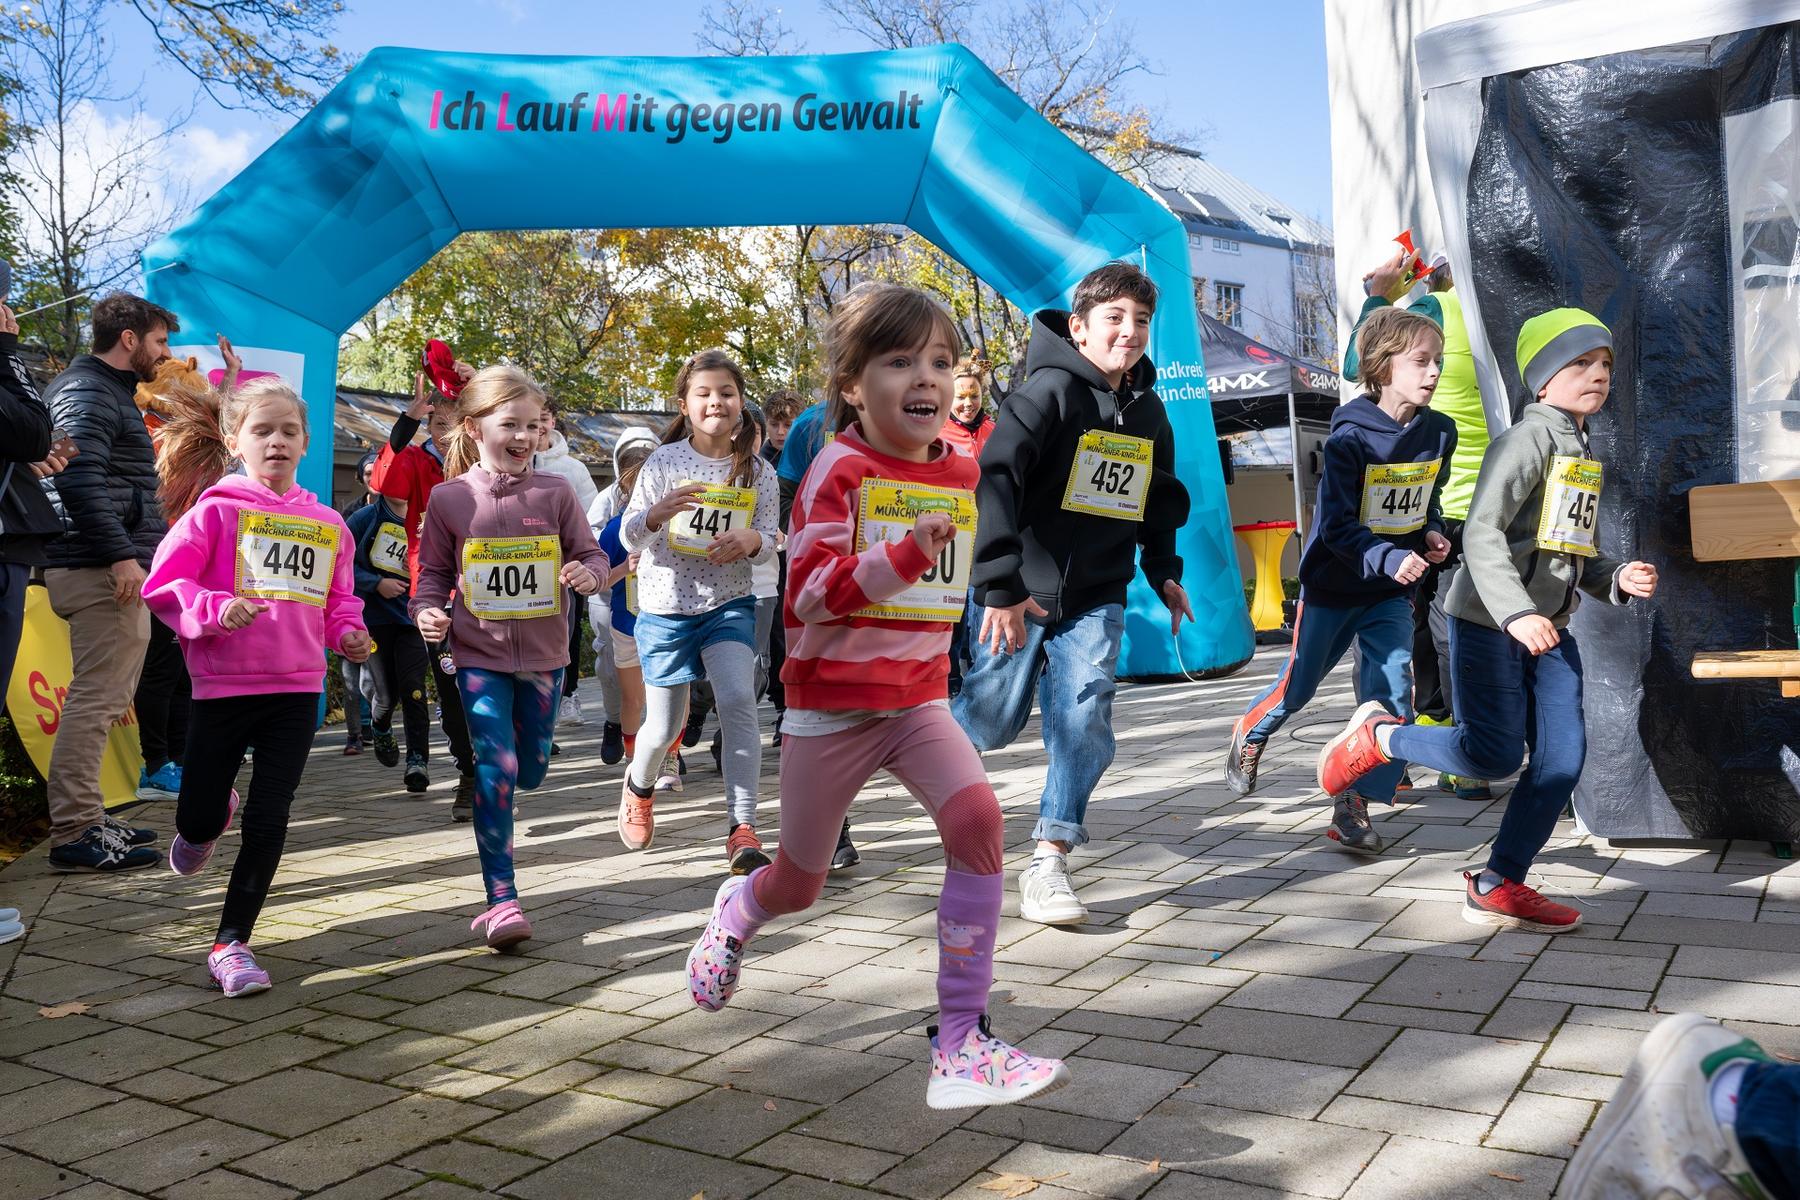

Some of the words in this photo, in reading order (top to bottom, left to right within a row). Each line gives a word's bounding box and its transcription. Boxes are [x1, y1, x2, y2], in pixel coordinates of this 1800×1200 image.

[428, 89, 487, 131] Ich
[496, 91, 589, 133] Lauf
[591, 92, 659, 133] Mit
[665, 101, 782, 144] gegen
[792, 89, 924, 132] Gewalt
[1156, 360, 1204, 380] ndkreis
[1206, 370, 1271, 394] 4MX
[1156, 382, 1207, 402] ünchen
[1090, 460, 1135, 496] 452
[1381, 486, 1423, 515] 444
[1567, 491, 1597, 530] 45
[248, 525, 333, 546] MÜNCHNER-KINDL-LAUF
[689, 507, 733, 537] 441
[263, 542, 316, 580] 449
[385, 541, 407, 562] 44
[470, 549, 553, 561] MÜNCHNER-KINDL-LAUF
[486, 564, 538, 597] 404
